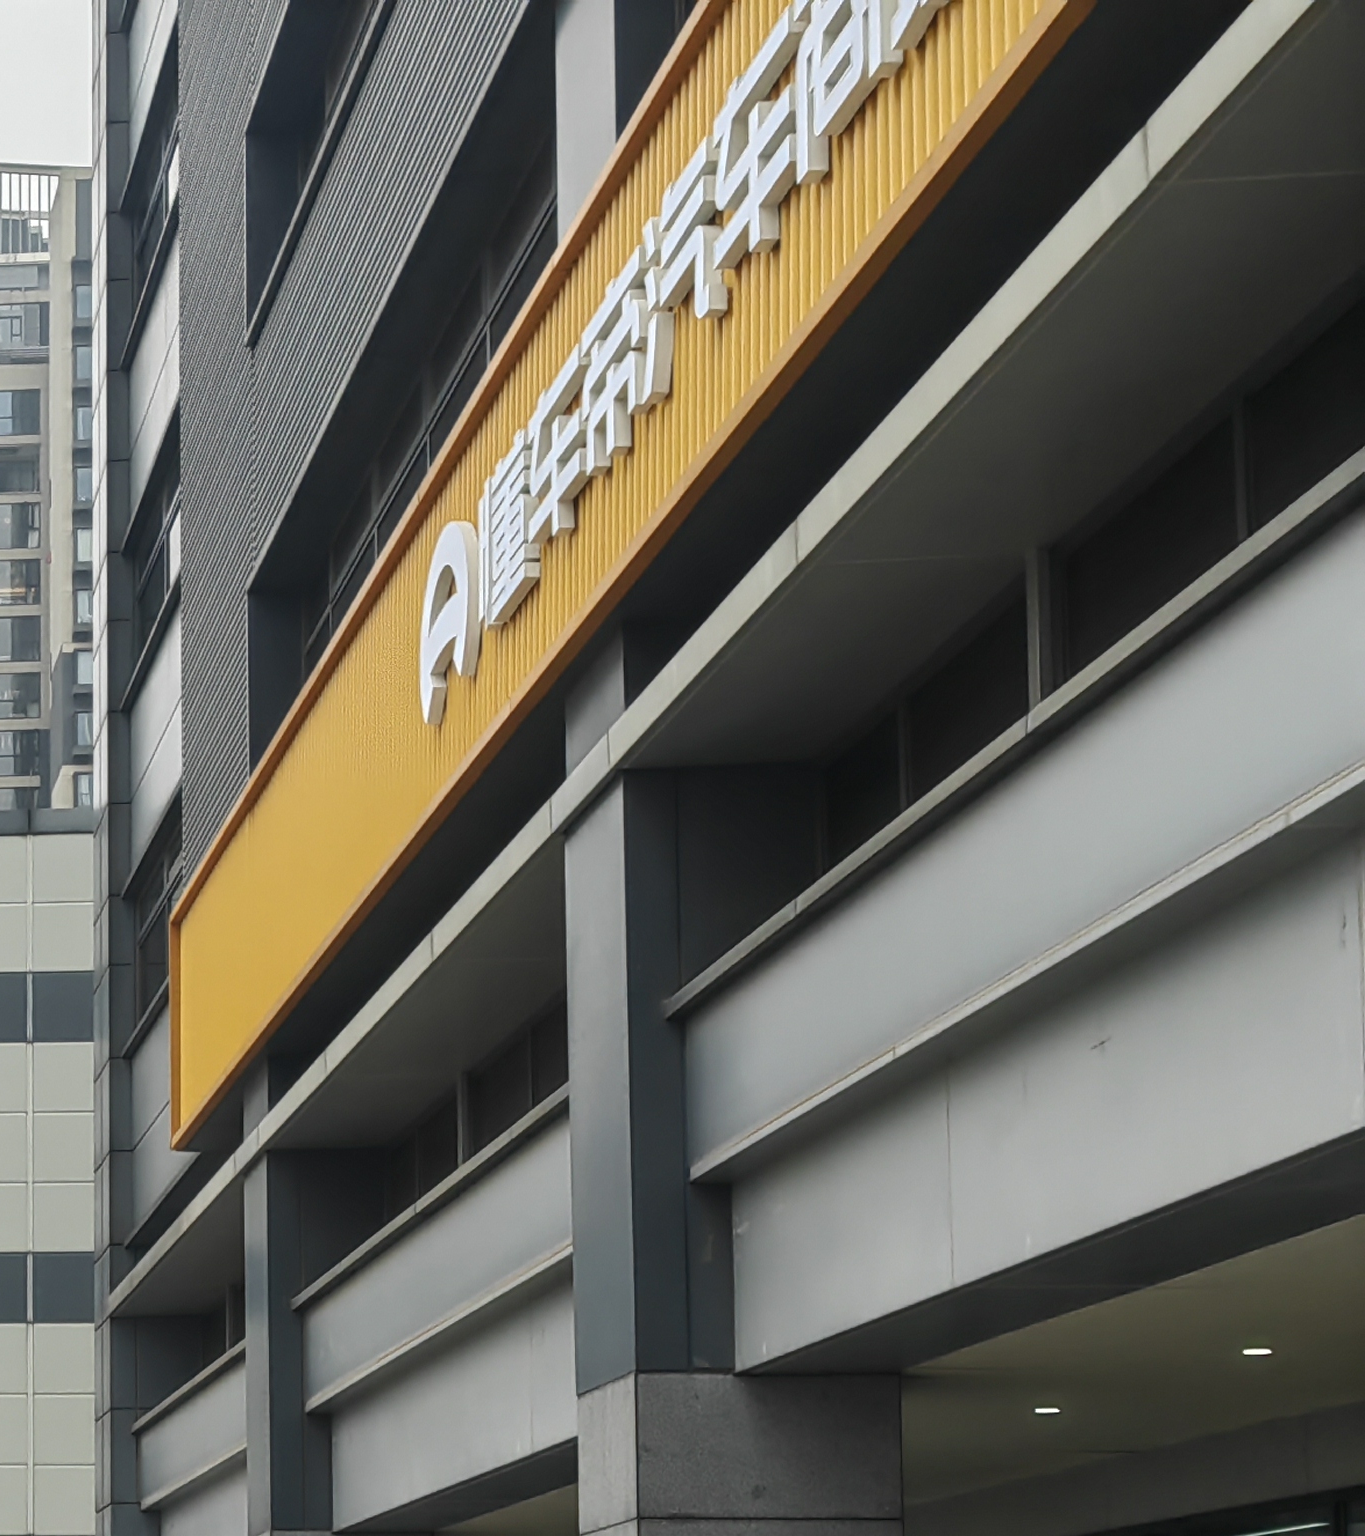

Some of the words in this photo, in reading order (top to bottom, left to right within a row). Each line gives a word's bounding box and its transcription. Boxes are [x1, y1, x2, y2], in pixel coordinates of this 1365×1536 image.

[478, 0, 947, 629] 懂车帝汽车商
